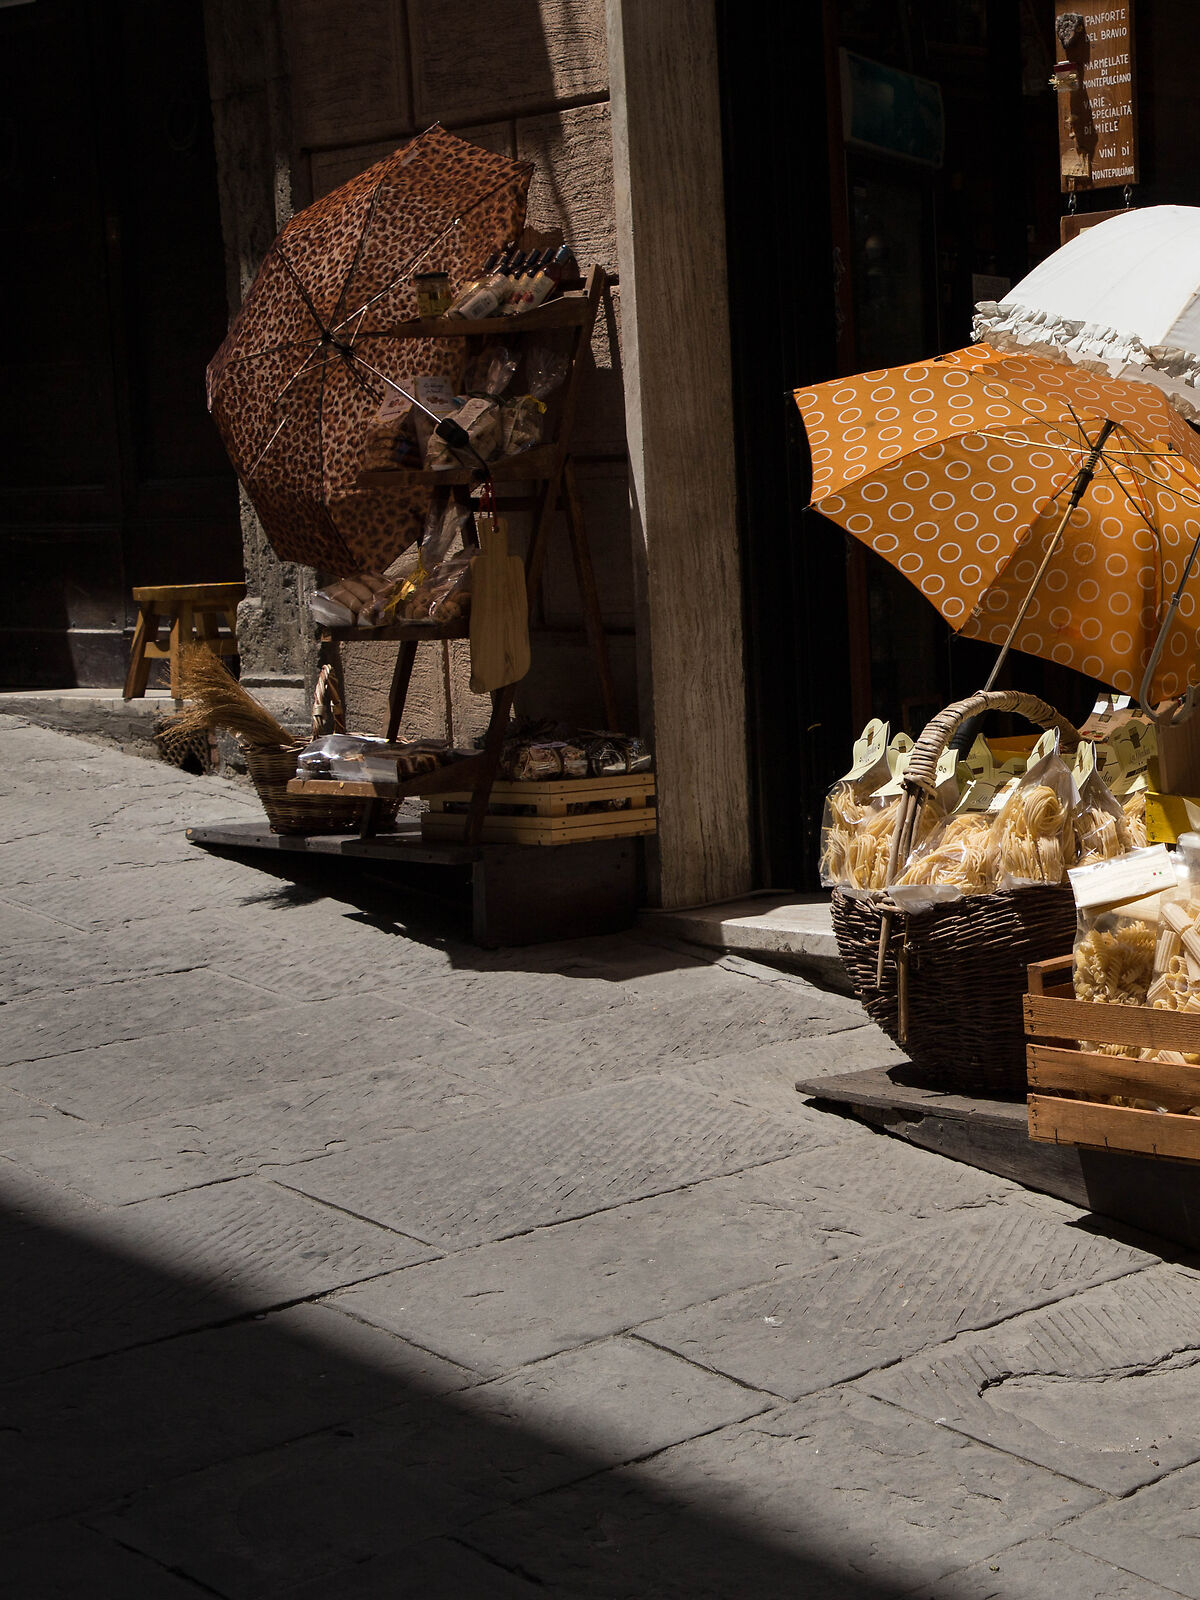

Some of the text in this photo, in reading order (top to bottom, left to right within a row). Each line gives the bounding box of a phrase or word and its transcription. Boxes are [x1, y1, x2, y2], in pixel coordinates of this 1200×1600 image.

[1085, 8, 1126, 26] PANFORTE
[1086, 31, 1098, 42] DEL
[1084, 53, 1129, 71] MARMELLATE
